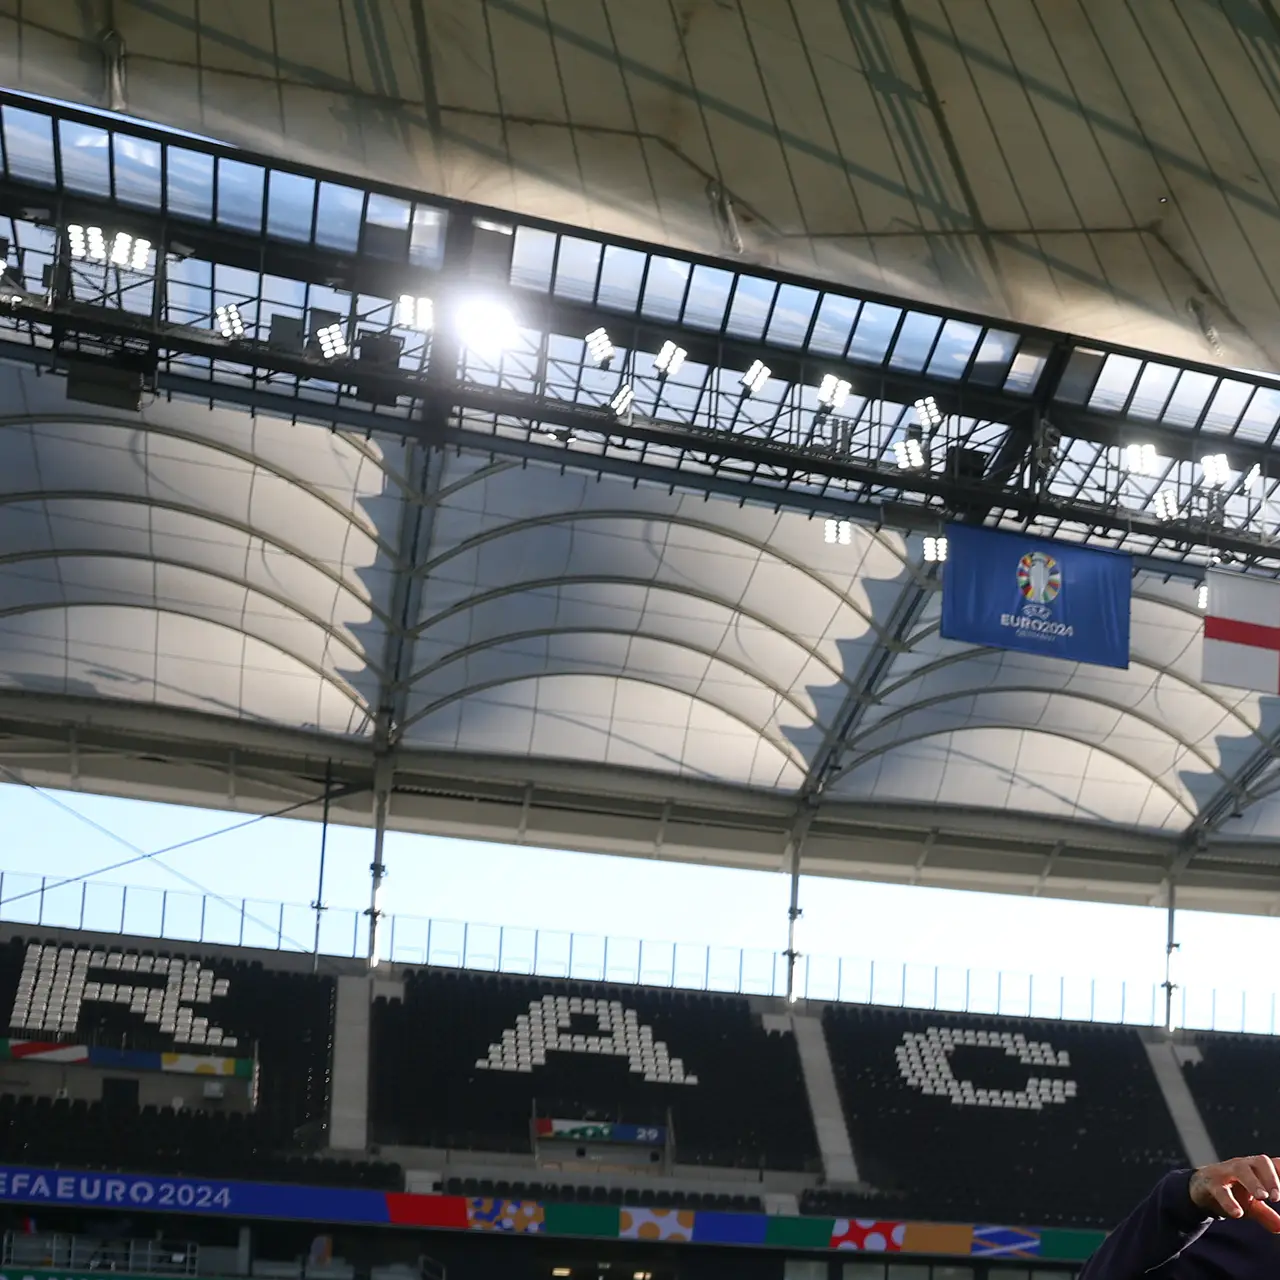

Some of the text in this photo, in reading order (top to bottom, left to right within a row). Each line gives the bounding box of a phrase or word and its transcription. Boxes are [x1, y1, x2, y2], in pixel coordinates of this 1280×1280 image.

[9, 943, 238, 1048] R
[475, 995, 698, 1085] A
[894, 1026, 1077, 1110] C
